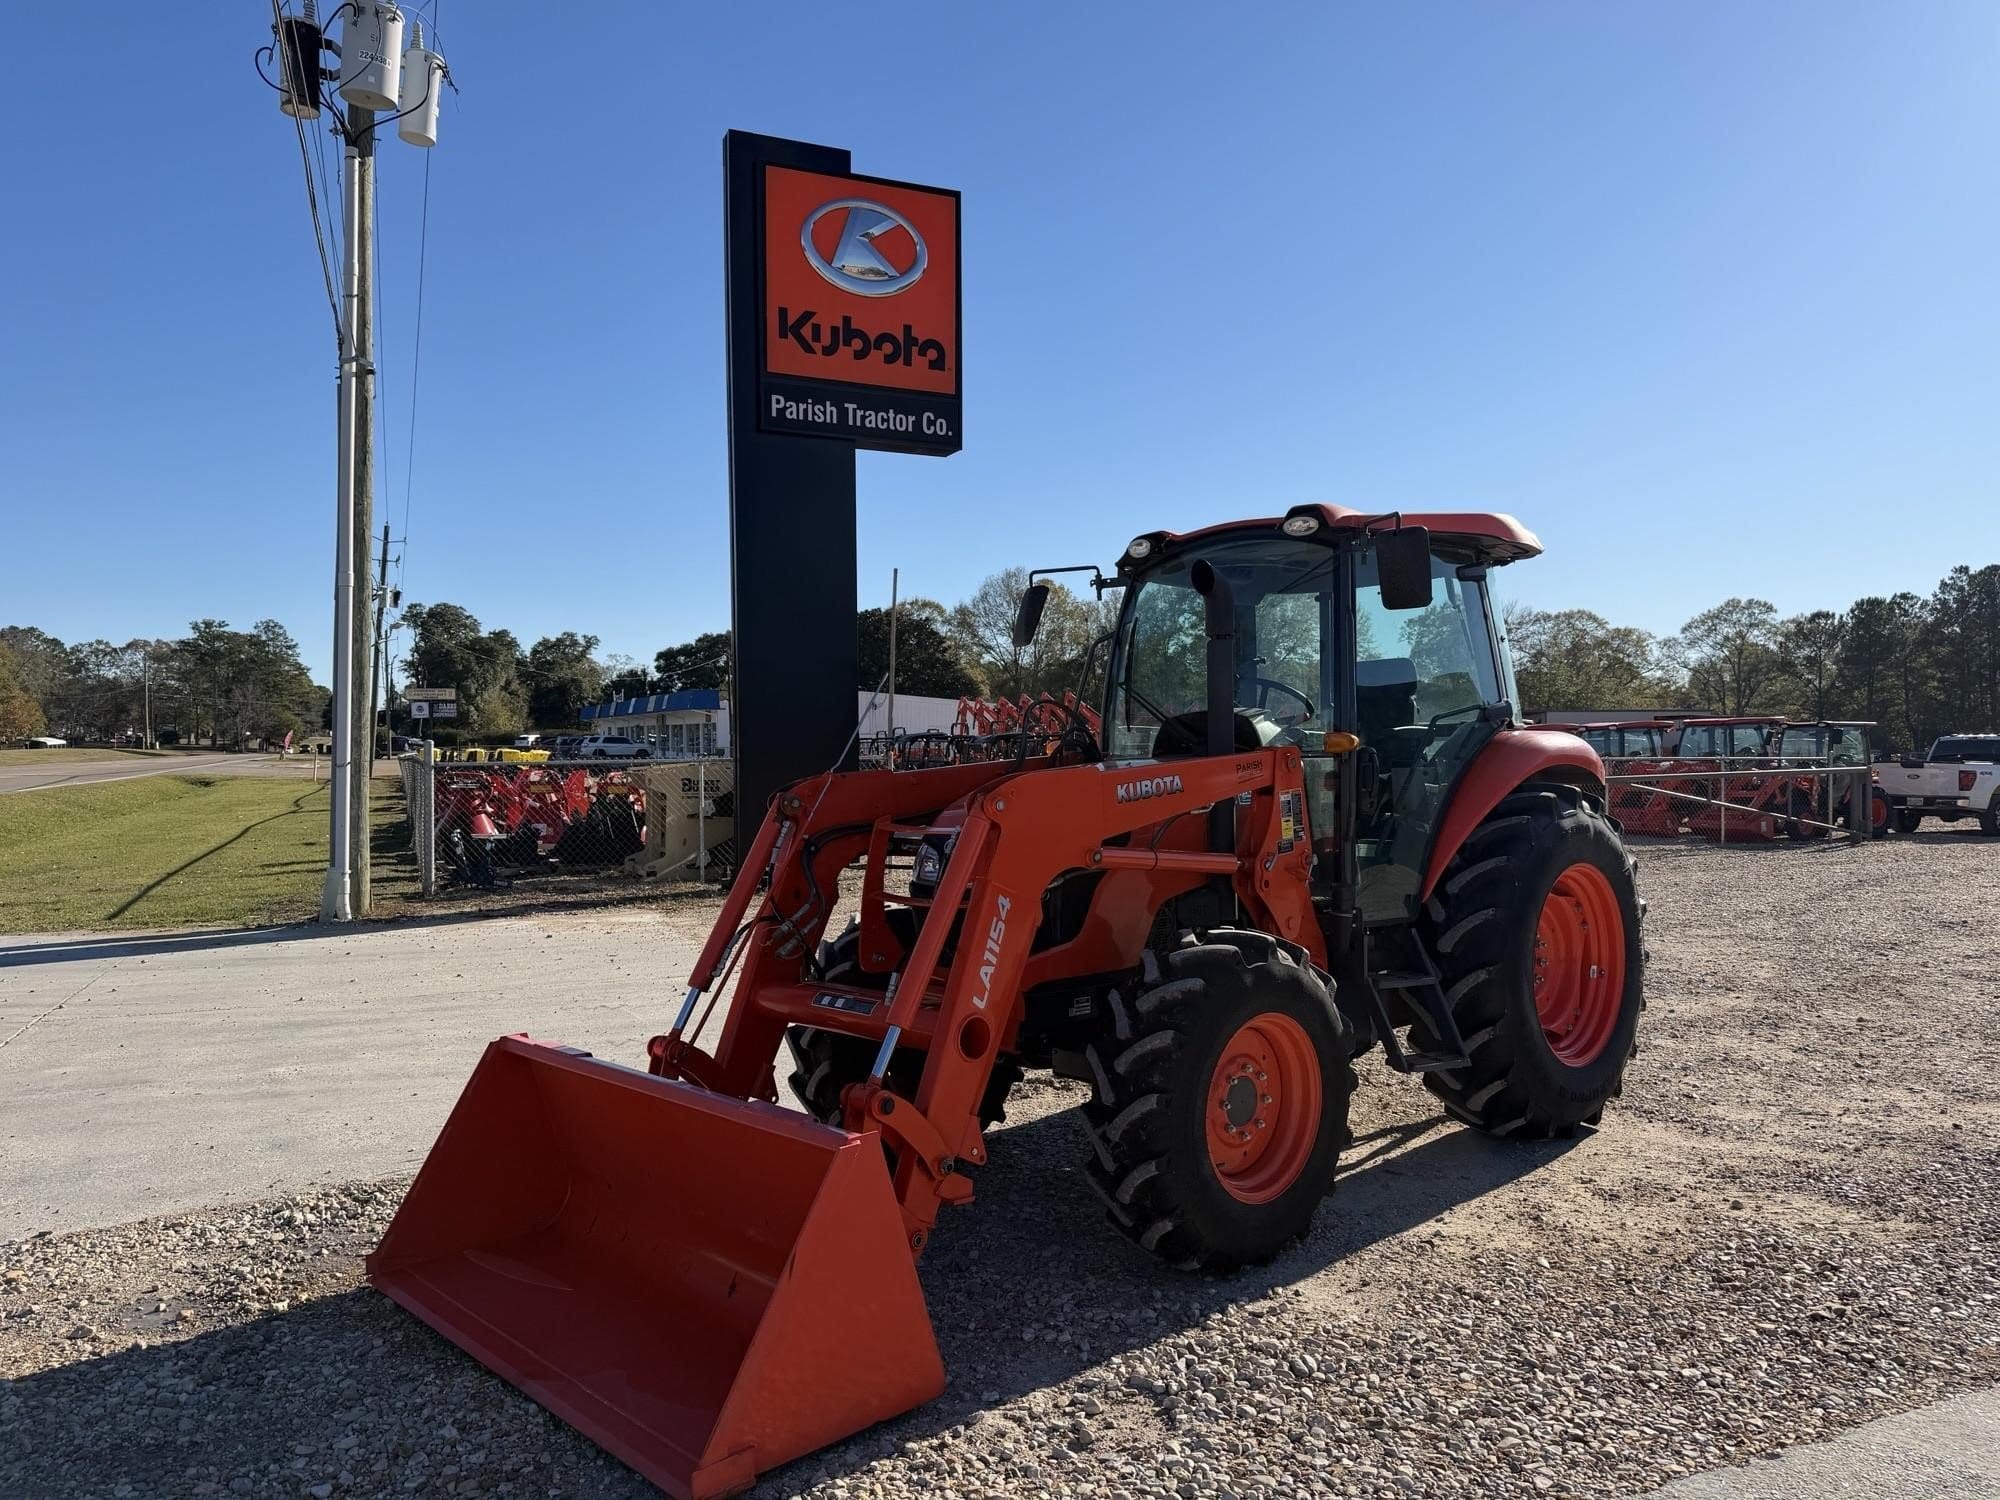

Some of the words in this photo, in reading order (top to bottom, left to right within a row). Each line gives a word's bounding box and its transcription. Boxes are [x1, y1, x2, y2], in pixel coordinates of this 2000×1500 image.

[778, 306, 946, 372] Kubota
[771, 395, 837, 424] Parish
[844, 403, 915, 432] Tractor
[922, 411, 952, 436] Co.
[1236, 759, 1264, 774] PARISH
[1116, 775, 1184, 803] KUBOTA
[972, 894, 1011, 1009] LA1154
